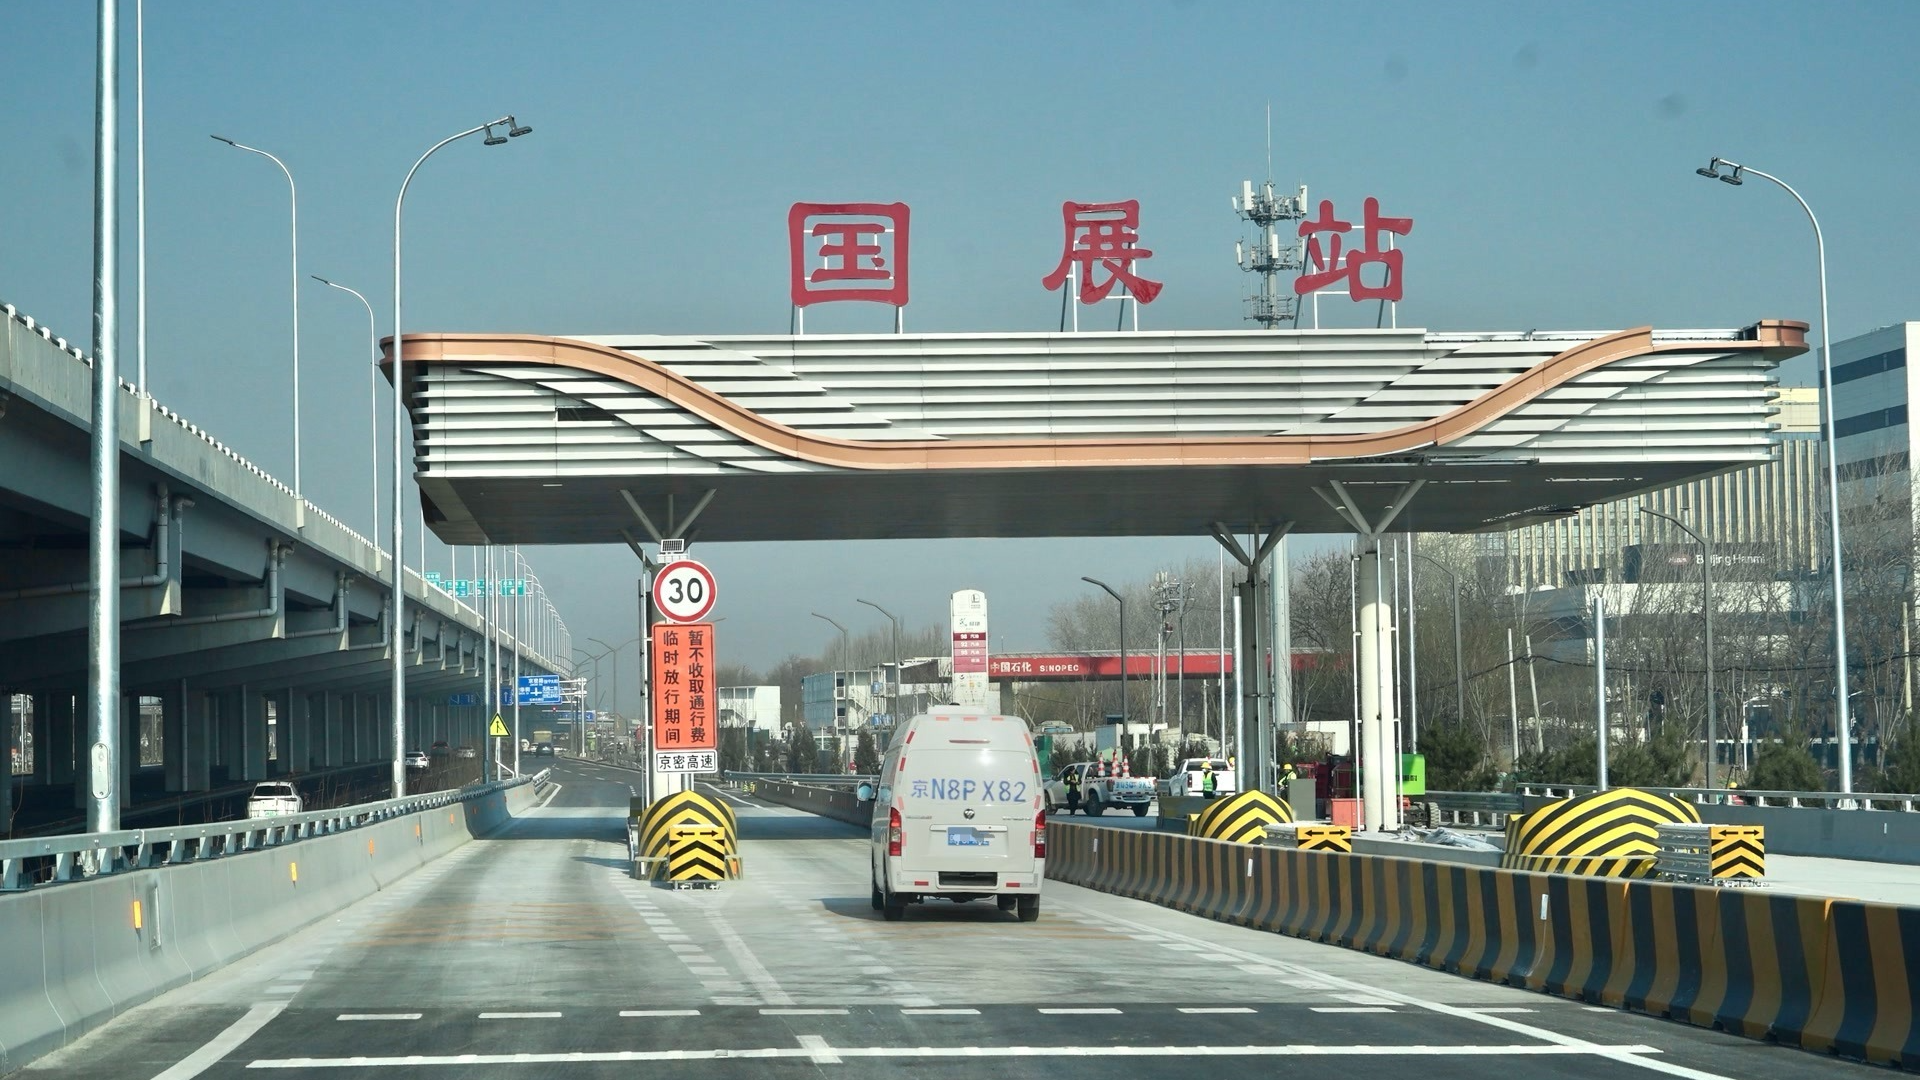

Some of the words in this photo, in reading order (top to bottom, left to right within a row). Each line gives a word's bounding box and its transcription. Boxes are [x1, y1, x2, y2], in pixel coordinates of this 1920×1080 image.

[788, 197, 1413, 308] 国展站
[668, 578, 703, 604] 30
[663, 630, 681, 744] 临时放行期间
[688, 630, 706, 743] 暂不收取通行费
[990, 661, 1032, 673] 中国石化
[1039, 664, 1079, 672] SINOPEC
[659, 754, 715, 770] 京密高速
